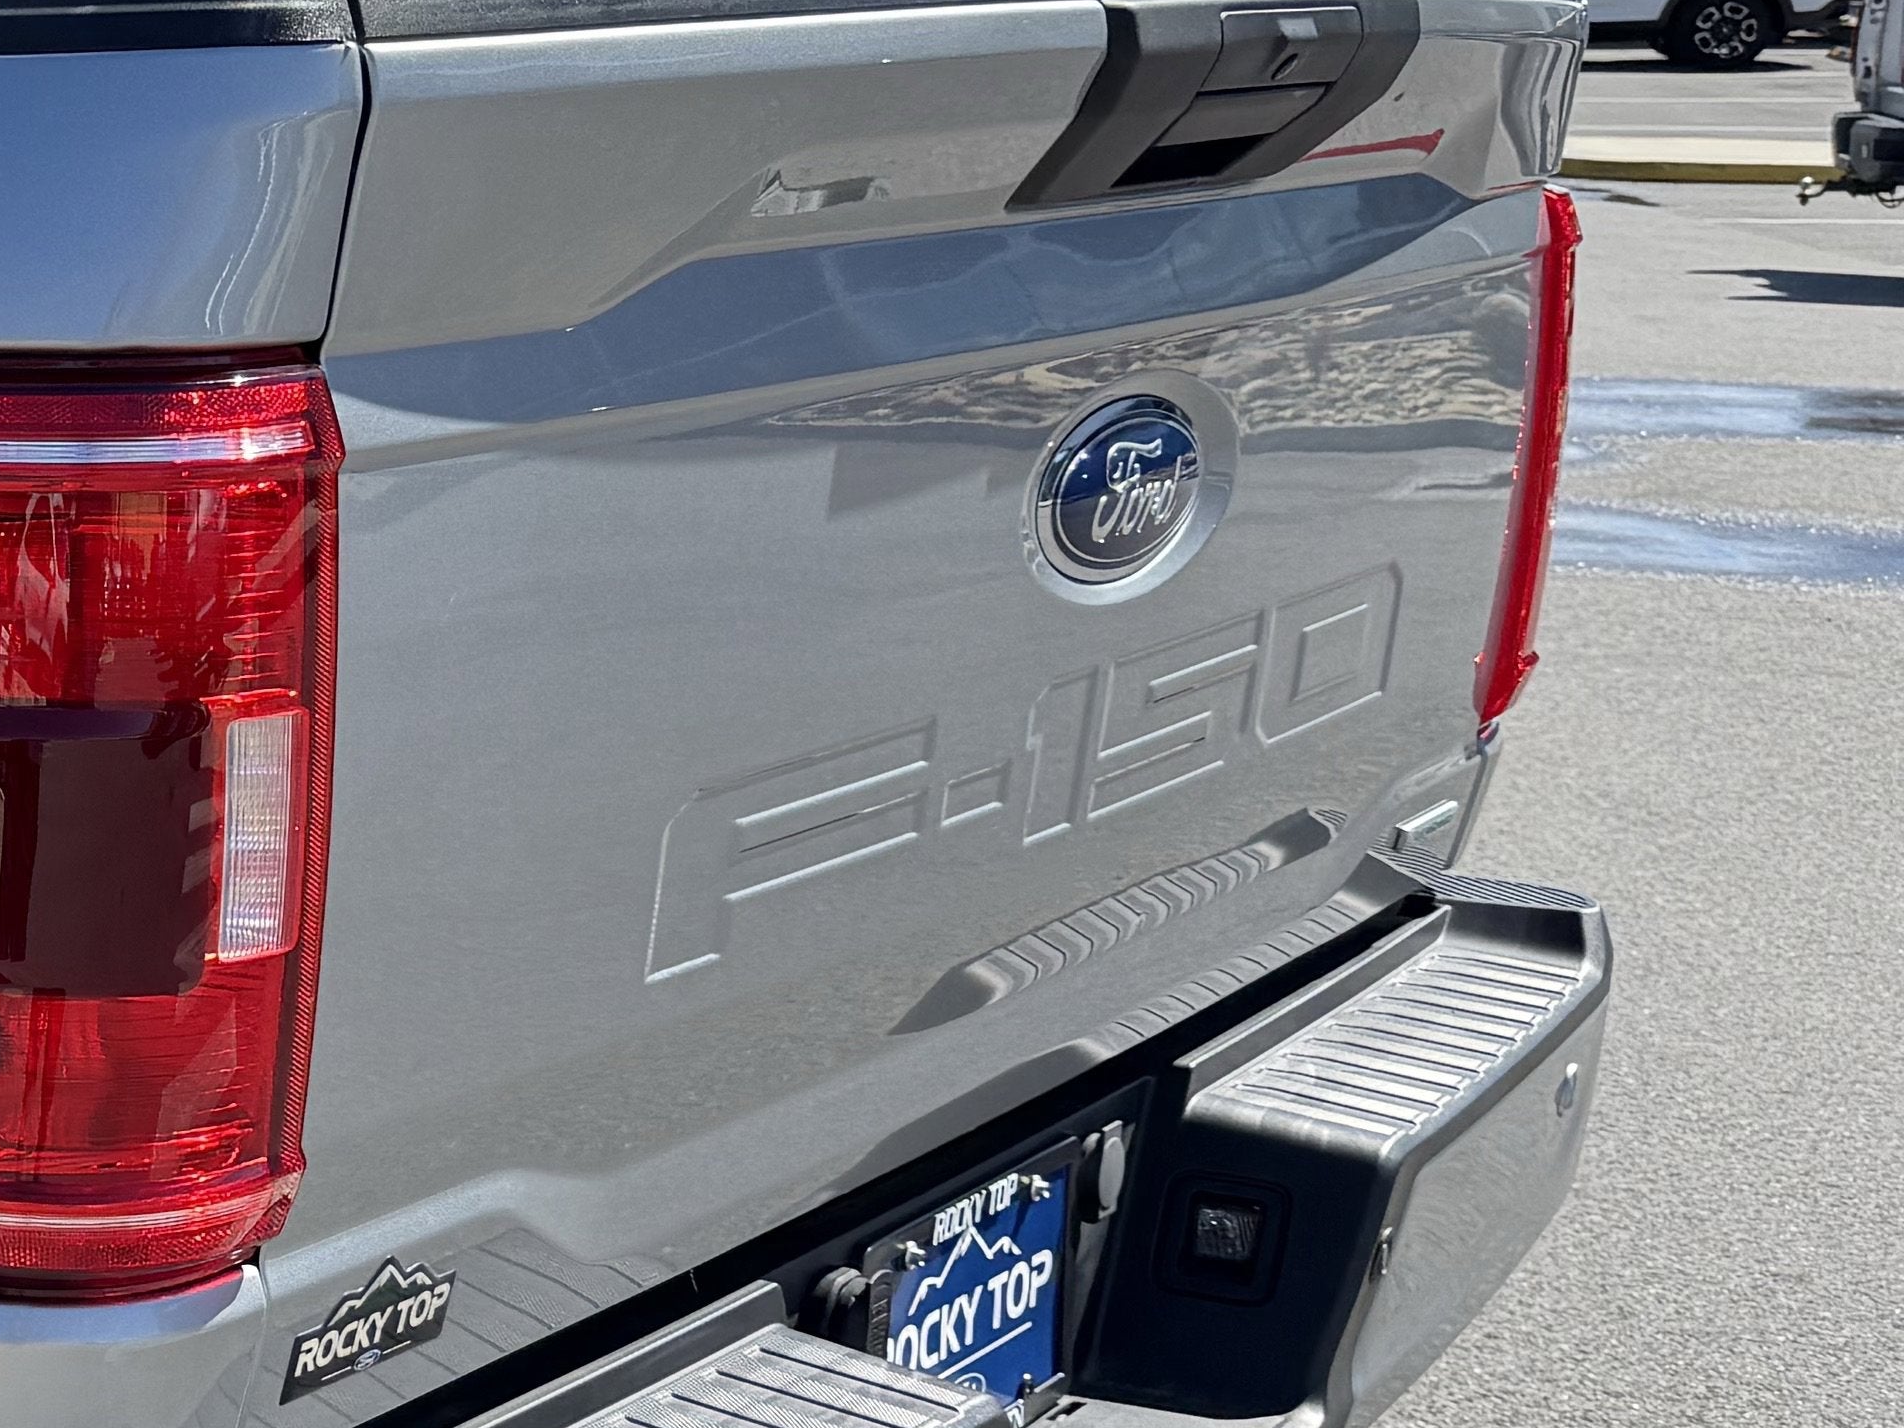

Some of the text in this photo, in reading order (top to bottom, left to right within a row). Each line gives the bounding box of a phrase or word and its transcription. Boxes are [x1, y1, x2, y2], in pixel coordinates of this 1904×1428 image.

[1092, 438, 1182, 544] Ford
[644, 562, 1404, 987] F-150
[930, 1172, 1019, 1247] ROCKY TOP
[294, 1282, 452, 1378] ROCKY TOP
[886, 1283, 984, 1371] OCKY
[987, 1248, 1053, 1330] TOP
